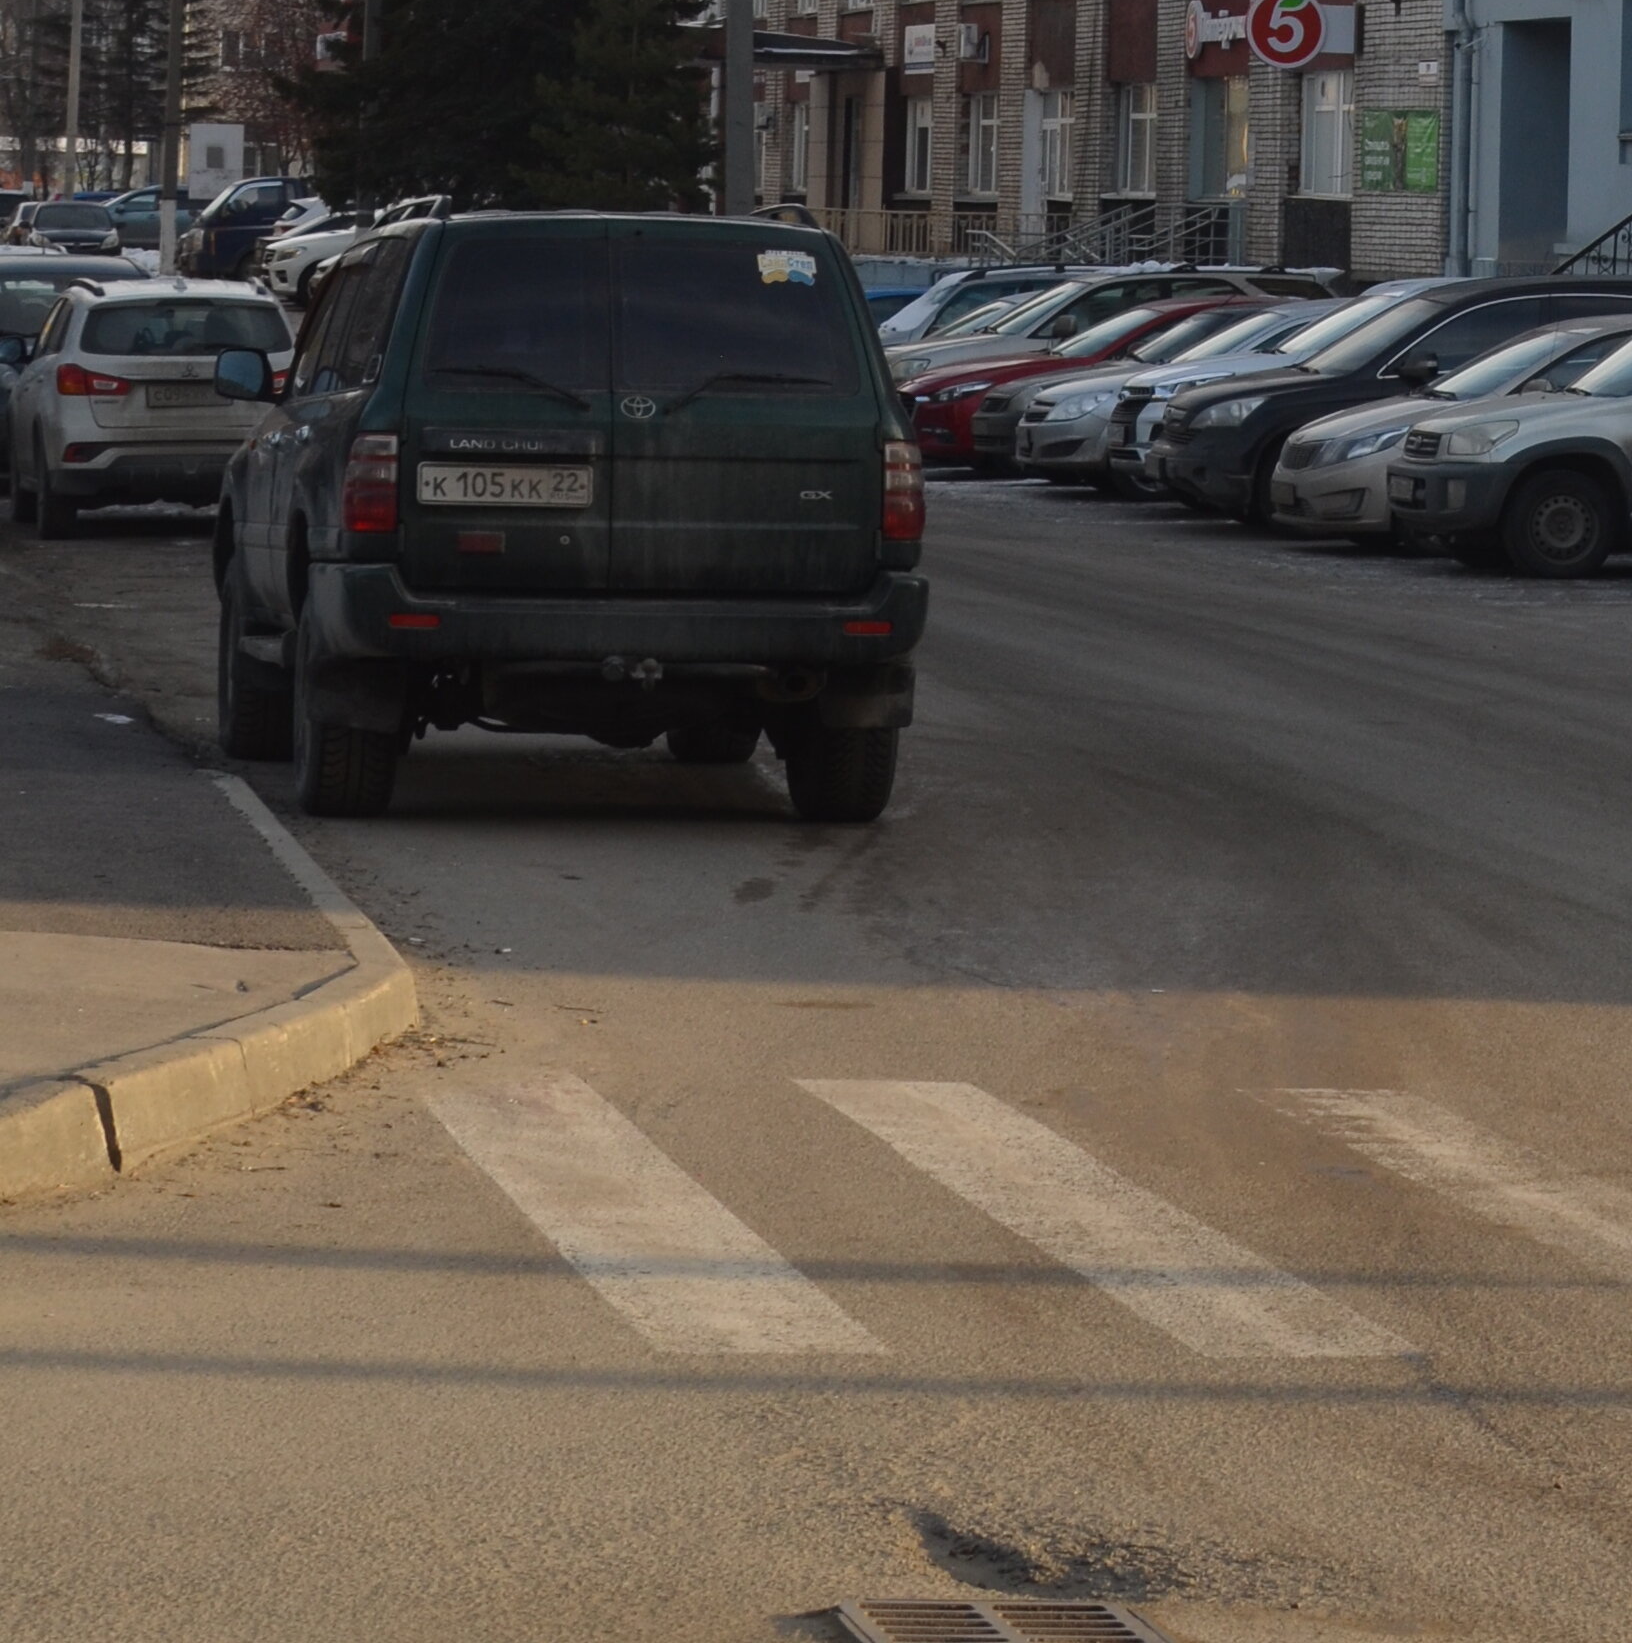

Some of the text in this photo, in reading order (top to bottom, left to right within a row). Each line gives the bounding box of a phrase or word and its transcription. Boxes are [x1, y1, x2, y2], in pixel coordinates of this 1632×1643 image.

[450, 439, 496, 450] LAND
[553, 472, 579, 492] 22
[800, 490, 833, 500] GX
